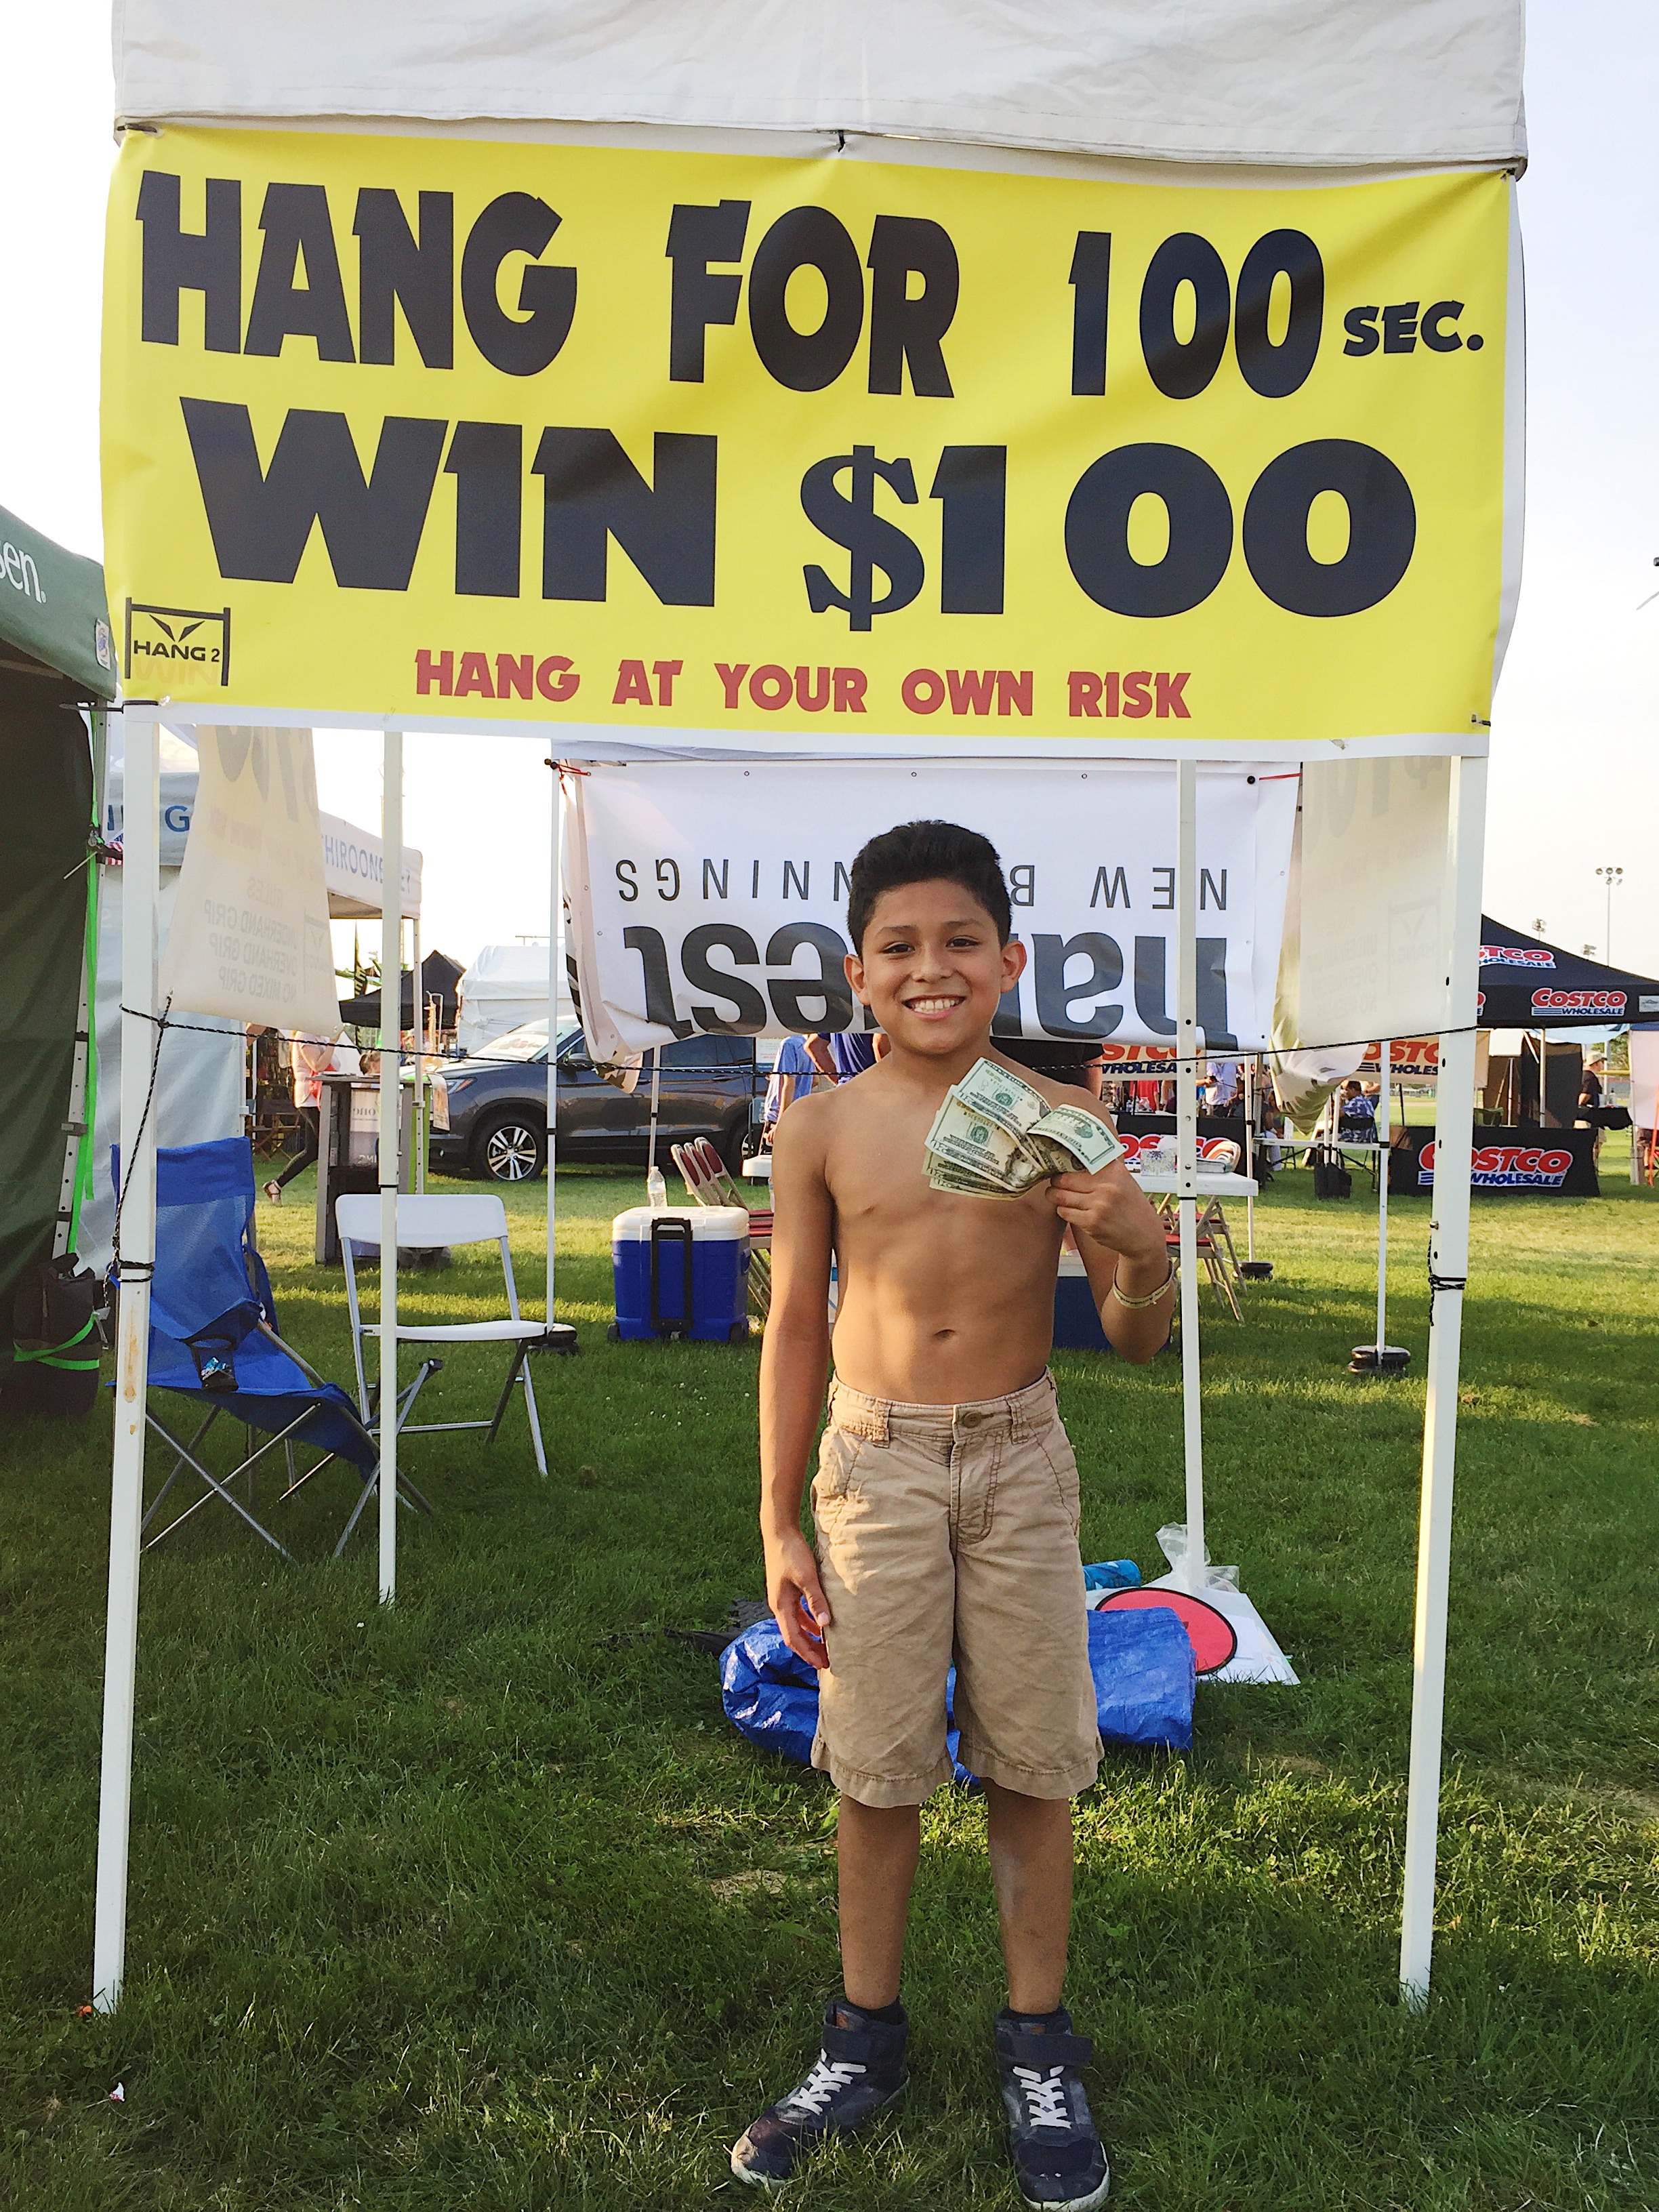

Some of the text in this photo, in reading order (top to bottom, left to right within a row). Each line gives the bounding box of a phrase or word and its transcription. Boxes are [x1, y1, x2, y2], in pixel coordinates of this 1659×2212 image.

[136, 170, 1484, 399] HANG FOR 100 SEC.
[180, 396, 1416, 632] WIN $100
[134, 640, 220, 662] HANG 2
[415, 649, 1192, 718] HANG AT YOUR OWN RISK
[1090, 866, 1227, 911] NEW
[1532, 989, 1626, 1007] COSTCO
